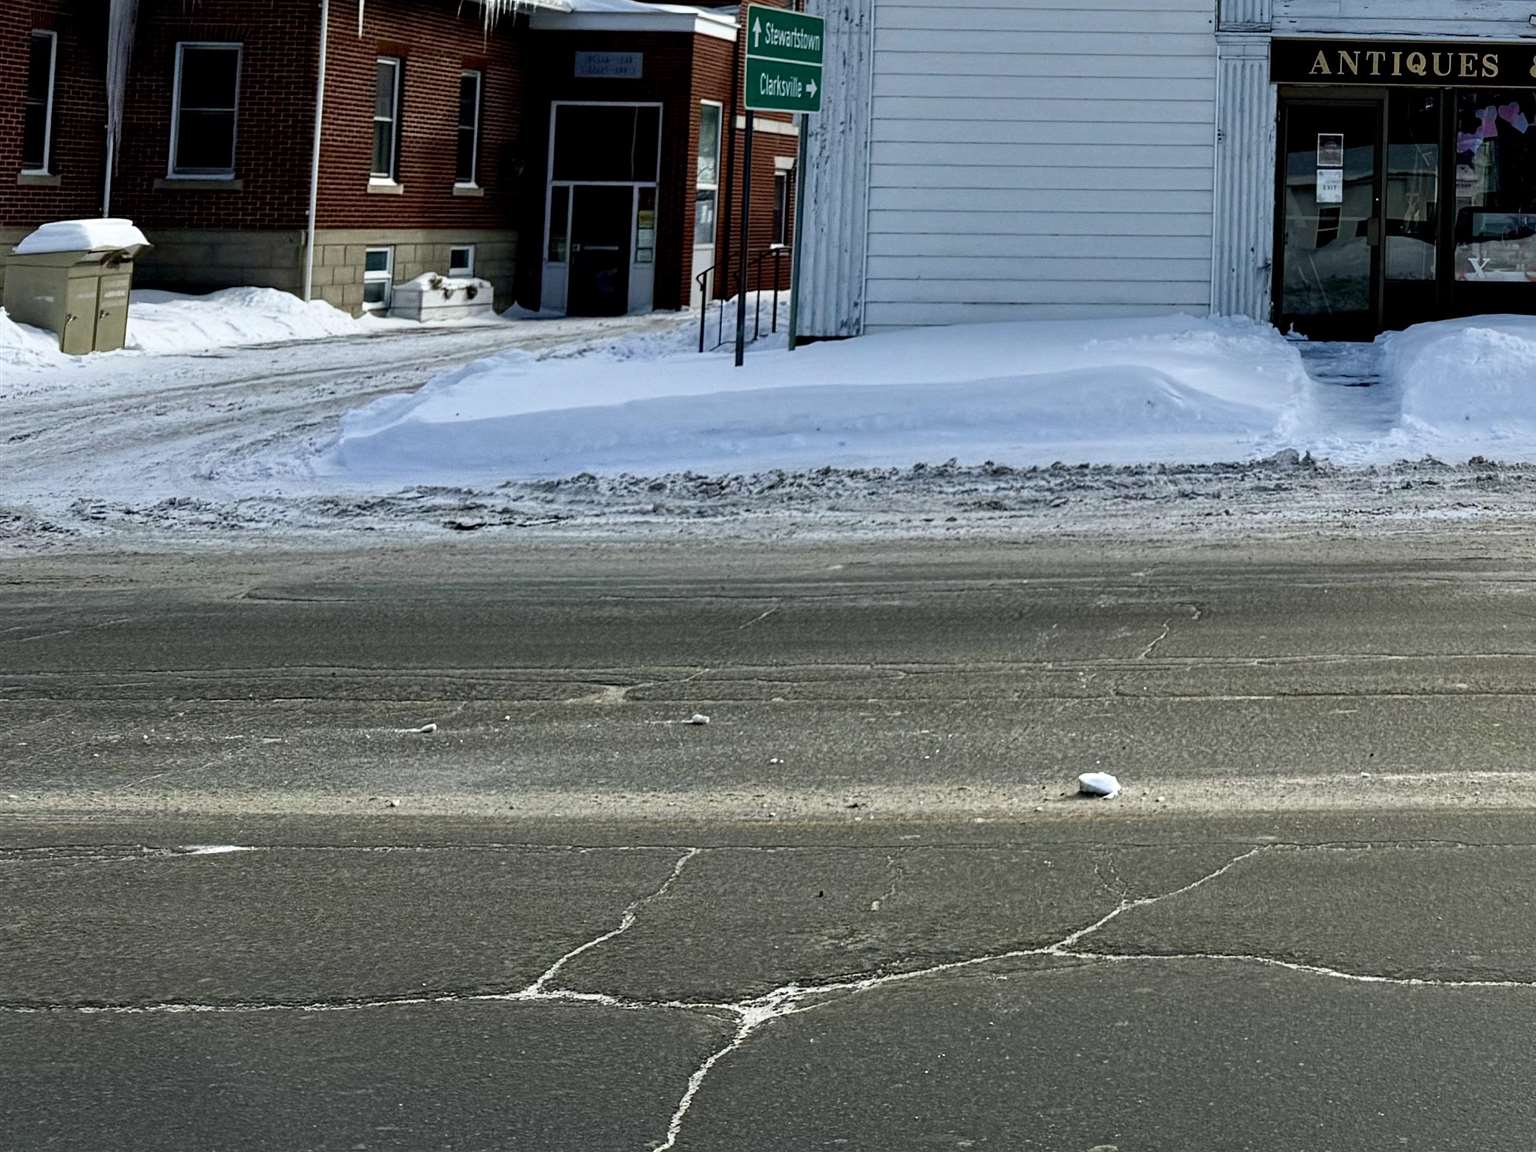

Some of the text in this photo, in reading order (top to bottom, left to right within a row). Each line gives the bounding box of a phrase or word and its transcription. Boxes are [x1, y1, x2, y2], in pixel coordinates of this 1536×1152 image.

[764, 21, 821, 52] Stewartstown
[1308, 49, 1500, 77] ANTIQUES
[760, 72, 803, 98] Clarksville
